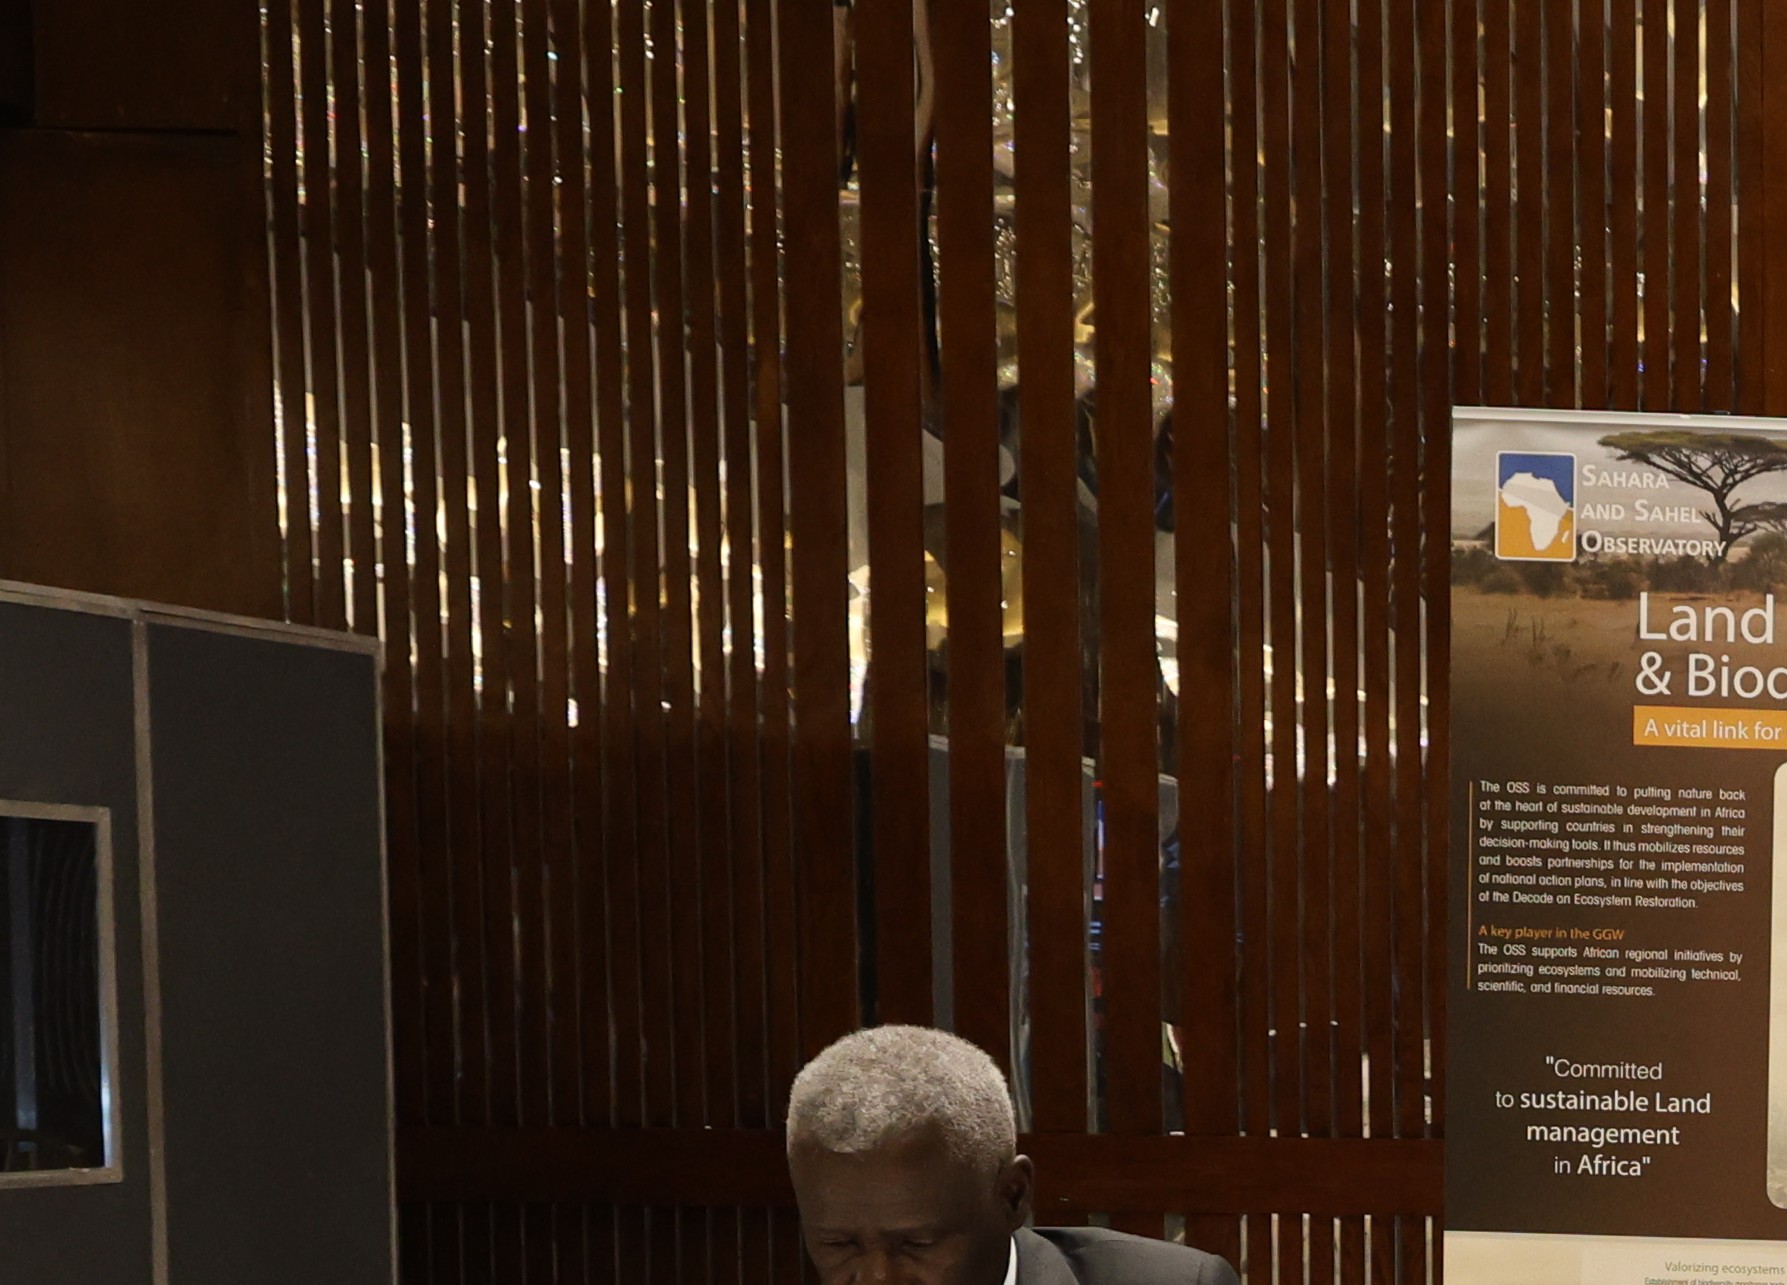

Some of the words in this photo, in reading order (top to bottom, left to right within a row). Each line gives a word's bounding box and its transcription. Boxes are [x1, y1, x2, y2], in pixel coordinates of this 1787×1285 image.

[1639, 591, 1775, 644] Land
[1635, 650, 1671, 696] &
[1644, 718, 1659, 736] A
[1664, 719, 1706, 737] vital
[1713, 719, 1749, 739] link
[1753, 720, 1782, 740] for
[1495, 1091, 1514, 1107] to
[1520, 1090, 1648, 1111] sustainable
[1655, 1092, 1710, 1113] Land
[1527, 1125, 1680, 1147] management
[1554, 1156, 1570, 1173] in
